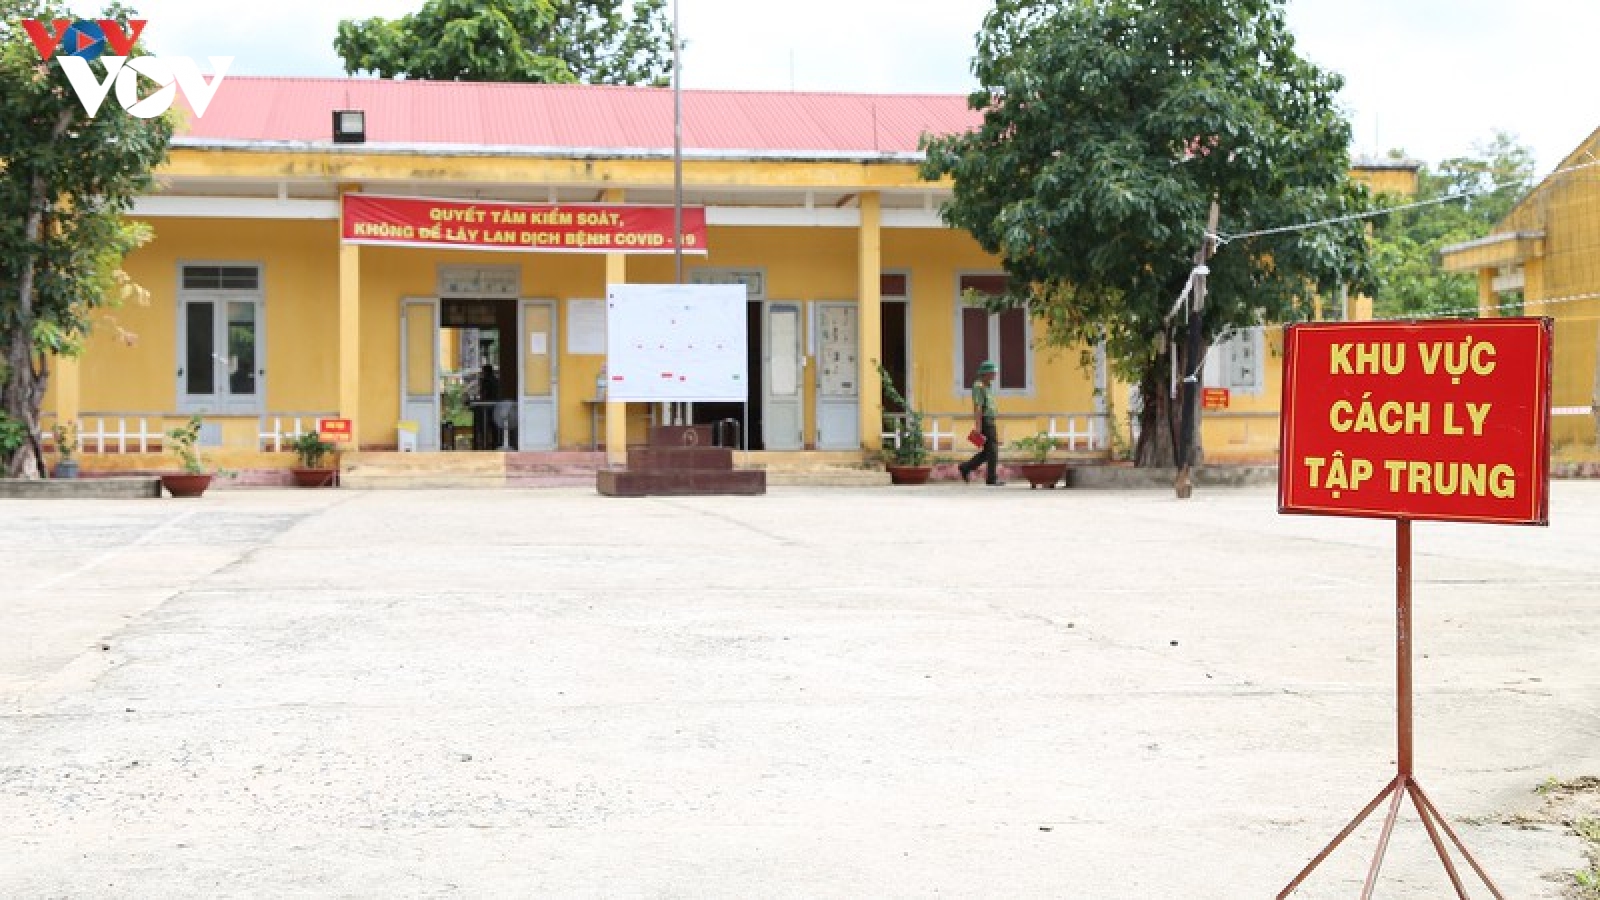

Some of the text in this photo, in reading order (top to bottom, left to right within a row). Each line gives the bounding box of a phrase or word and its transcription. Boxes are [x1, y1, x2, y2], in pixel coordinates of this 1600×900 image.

[353, 222, 415, 238] KHÔNG
[446, 226, 479, 241] LÂY
[484, 229, 517, 243] LAN
[521, 231, 561, 247] DỊCH
[565, 230, 611, 247] BỆNH
[615, 232, 665, 246] COVID
[430, 206, 486, 222] QUYẾT
[490, 209, 527, 224] TÂM
[531, 208, 573, 225] KIỂM
[1329, 335, 1497, 385] KHU VỰC
[1329, 391, 1492, 436] CÁCH LY
[1304, 450, 1516, 499] TẬP TRUNG
